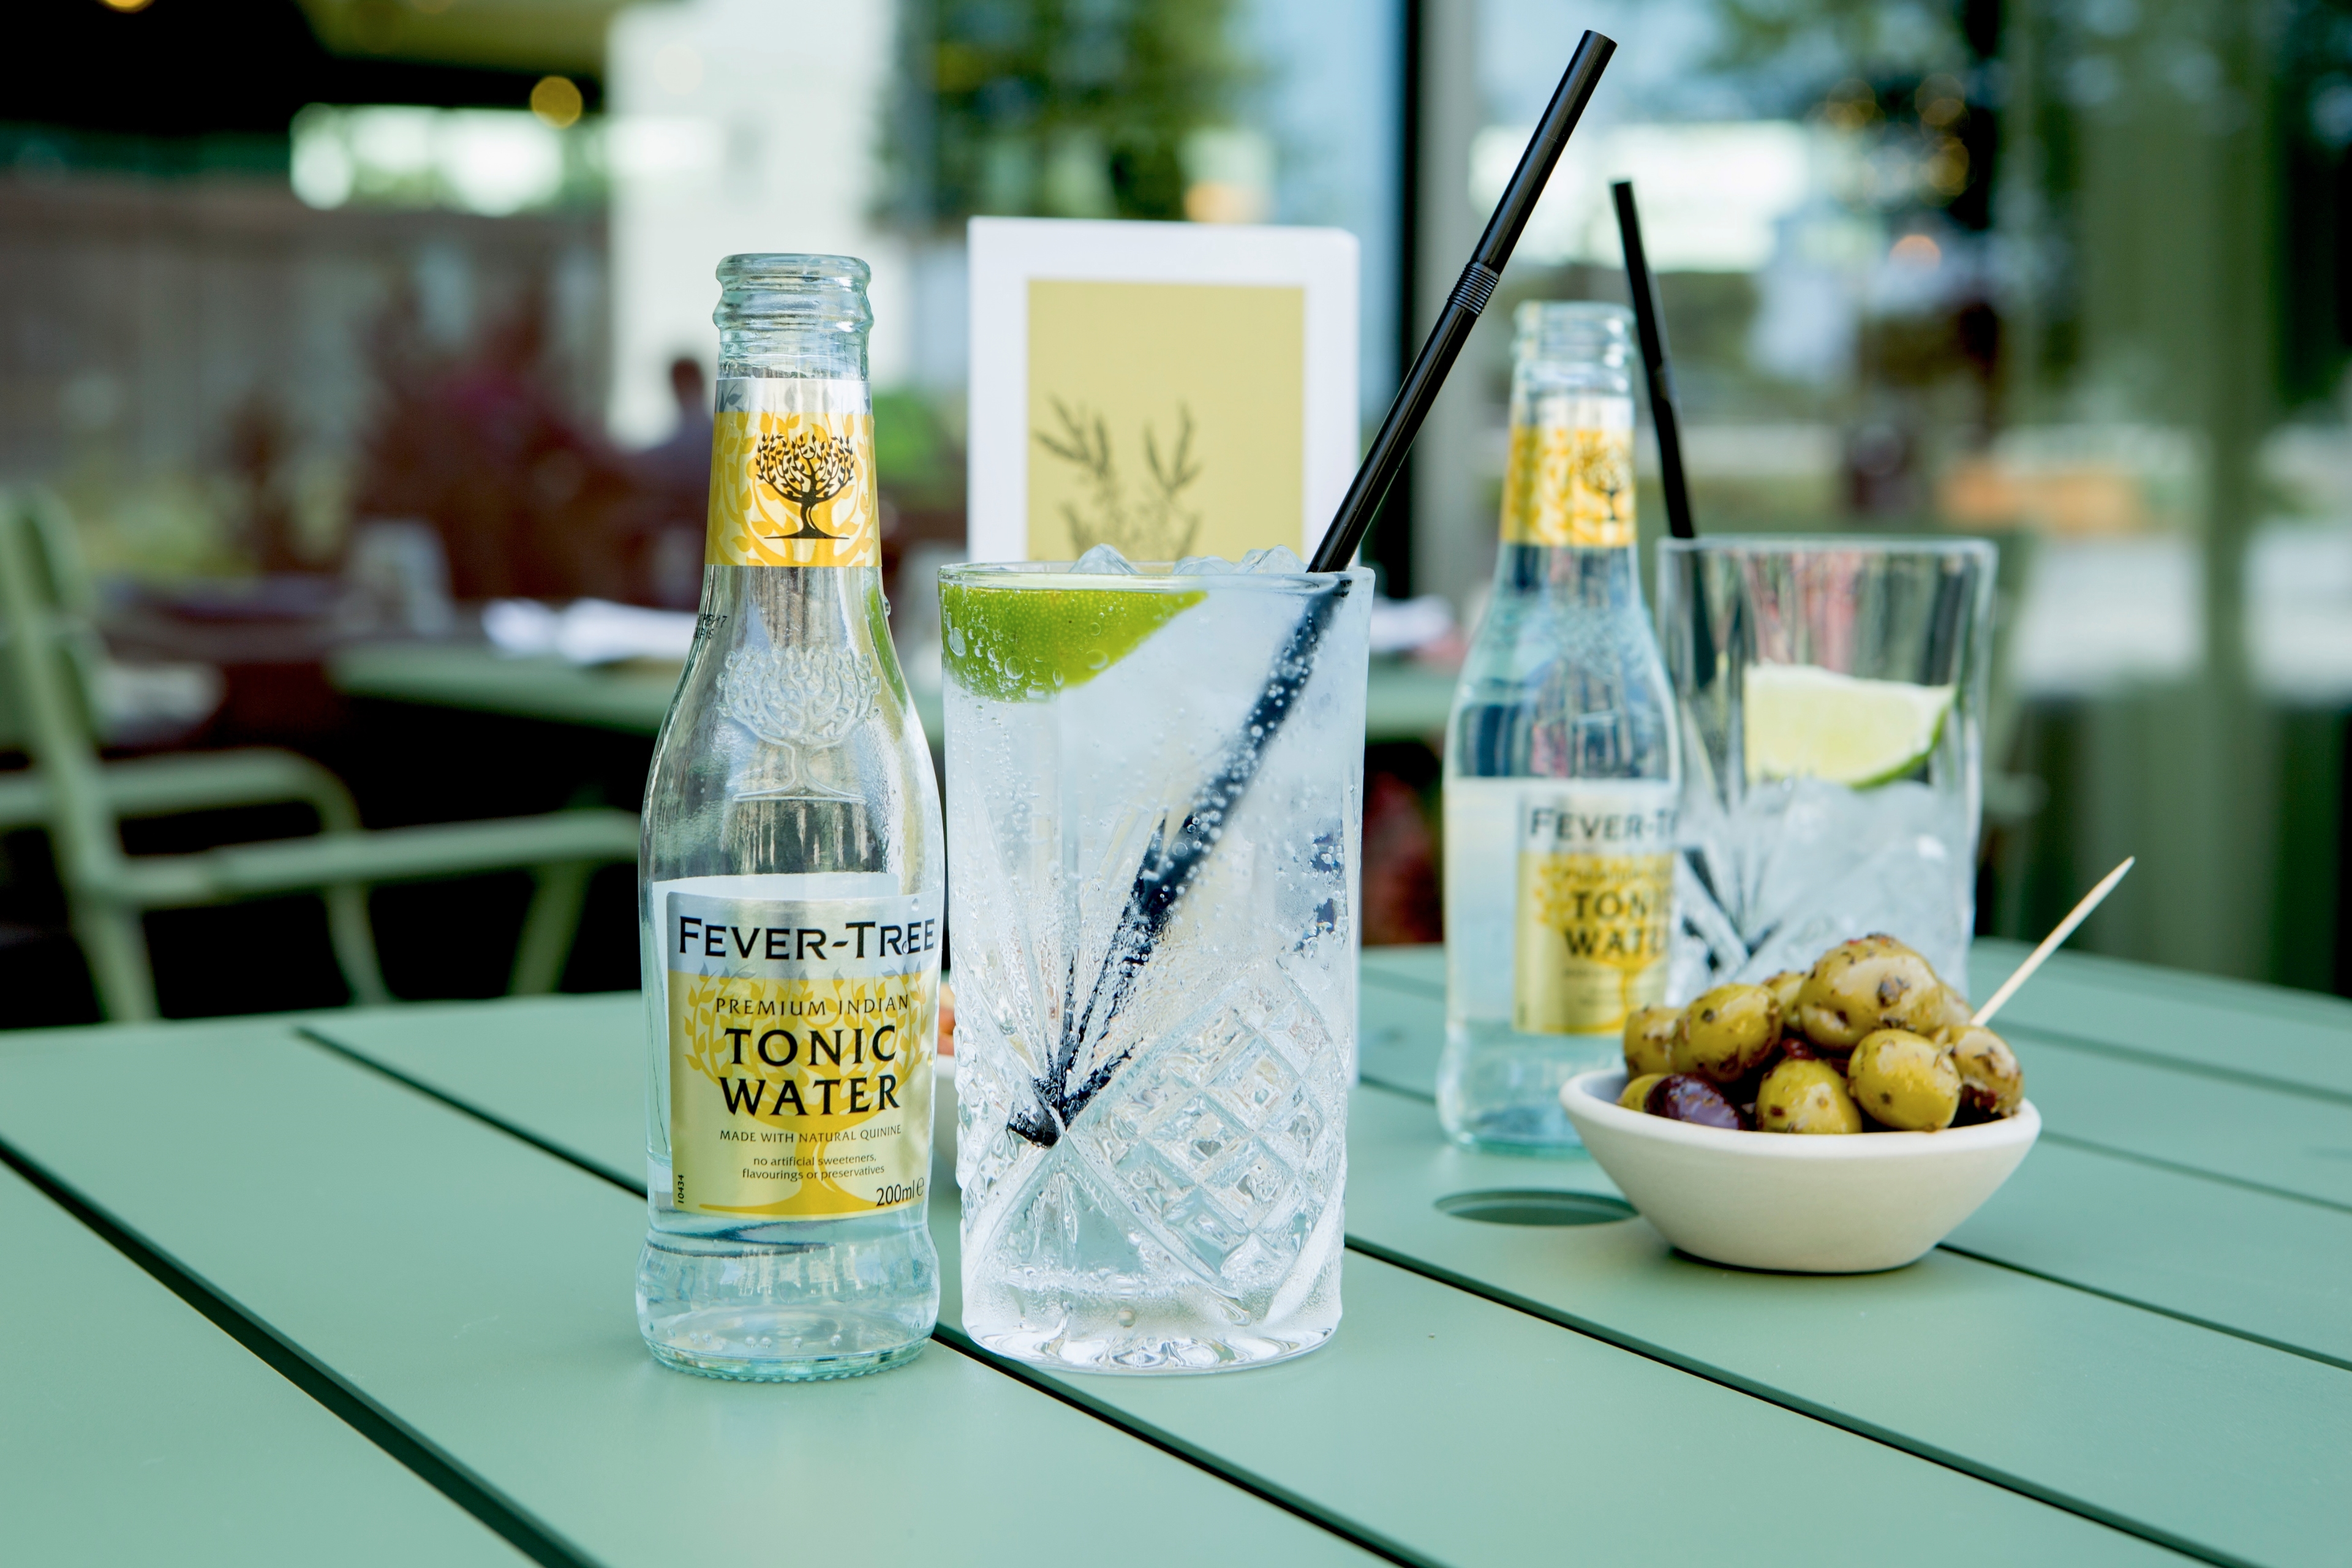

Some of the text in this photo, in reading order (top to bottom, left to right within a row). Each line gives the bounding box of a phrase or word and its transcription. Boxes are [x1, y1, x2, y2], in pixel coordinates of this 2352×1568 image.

[679, 916, 935, 960] FEVER-TREE
[716, 994, 909, 1016] PREMIUM INDIAN
[723, 1025, 896, 1067] TONIC
[717, 1074, 901, 1117] WATER
[720, 1125, 902, 1143] MADE WITH NATURAL QUININE
[753, 1153, 877, 1166] no artificial sweeteners,
[742, 1168, 804, 1182] flavourings
[821, 1165, 885, 1181] preservatives
[875, 1179, 915, 1207] 200ml
